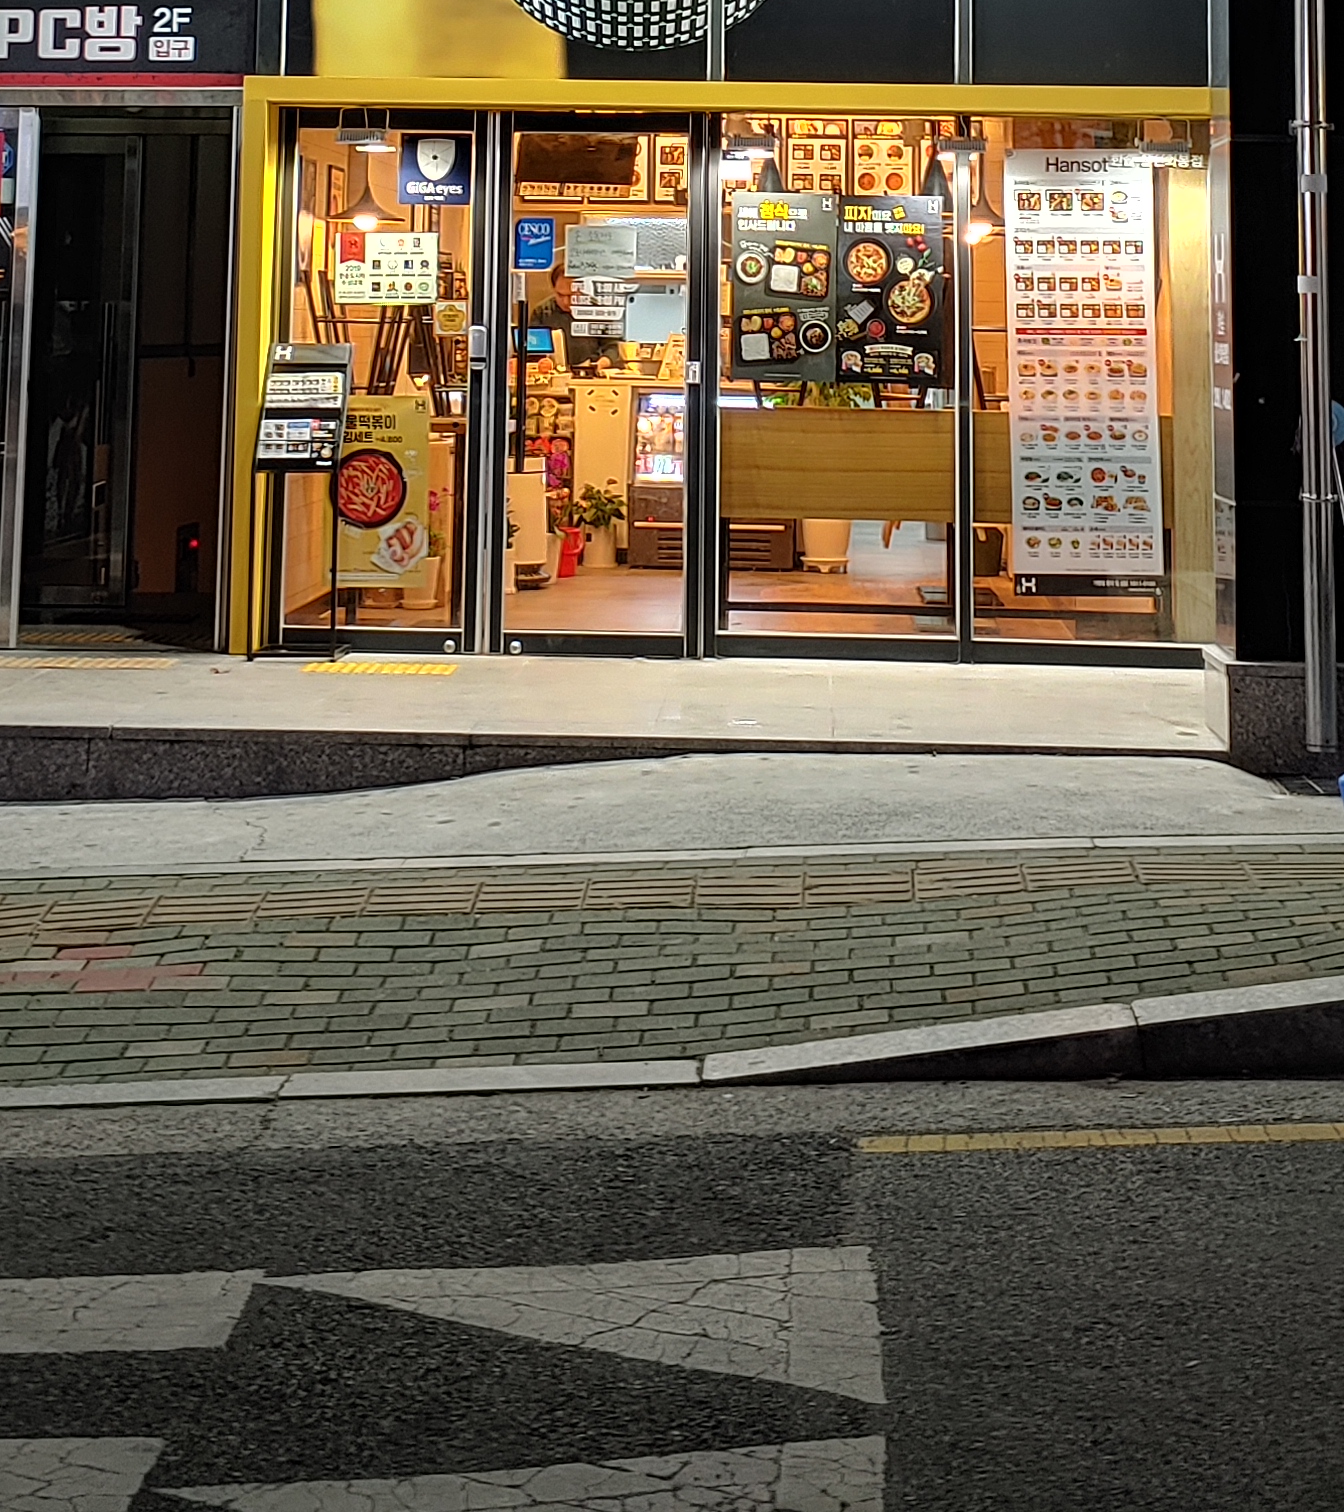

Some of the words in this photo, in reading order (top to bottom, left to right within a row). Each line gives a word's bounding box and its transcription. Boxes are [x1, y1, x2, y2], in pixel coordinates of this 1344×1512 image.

[152, 6, 193, 33] 2F
[150, 37, 192, 60] 입구
[1045, 156, 1109, 174] Hansot
